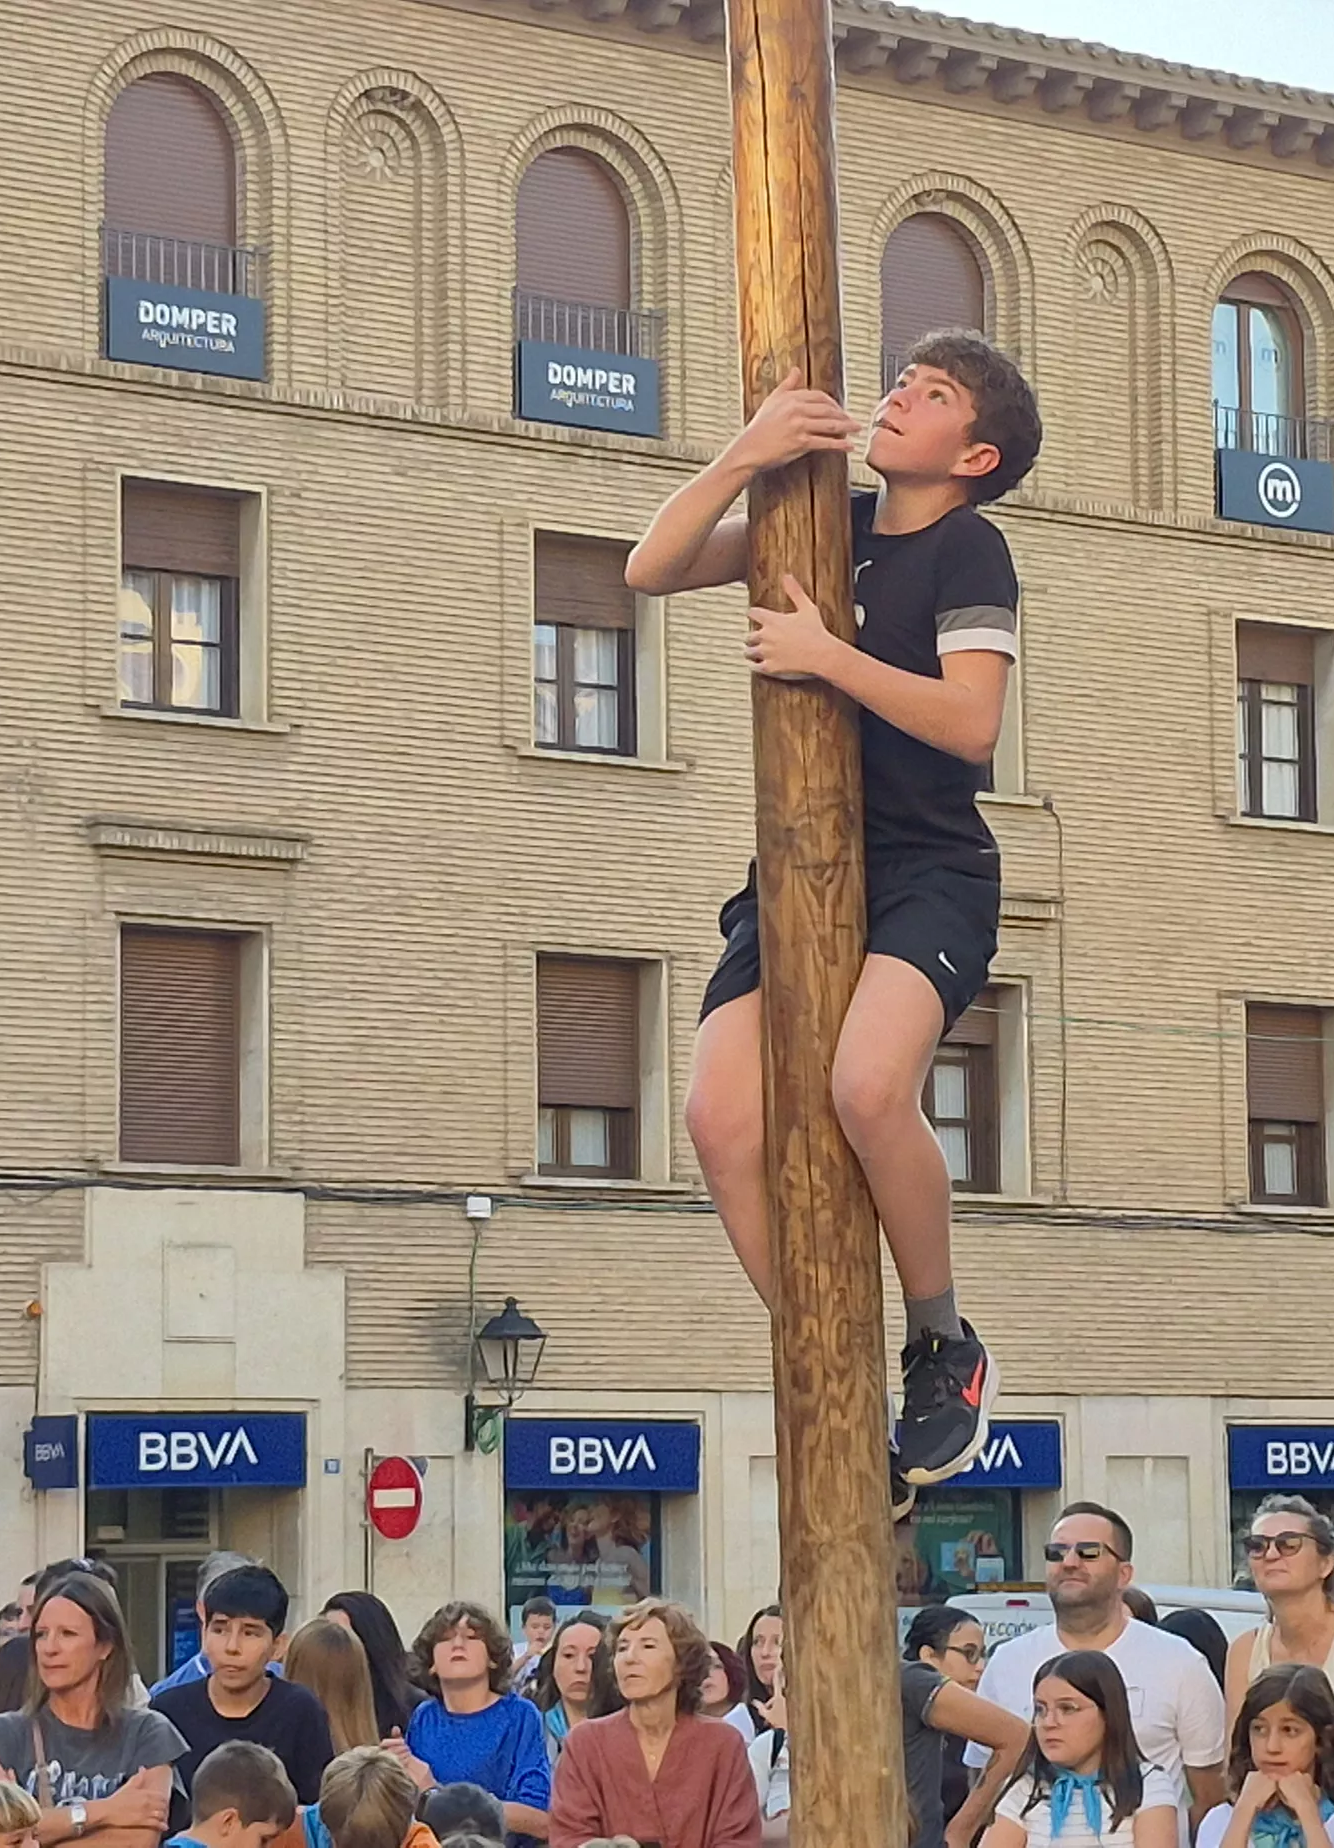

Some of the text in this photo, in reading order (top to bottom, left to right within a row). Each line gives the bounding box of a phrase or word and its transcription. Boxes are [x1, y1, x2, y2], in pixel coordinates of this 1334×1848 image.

[139, 299, 237, 337] DOMPER
[141, 327, 236, 354] ARQUITECTURA
[547, 361, 636, 396] DOMPER
[549, 388, 635, 412] ARQUITECTURA
[34, 1442, 65, 1462] BBVA
[138, 1426, 259, 1471] BBVA
[549, 1433, 657, 1475] BBVA
[961, 1433, 1023, 1473] VA
